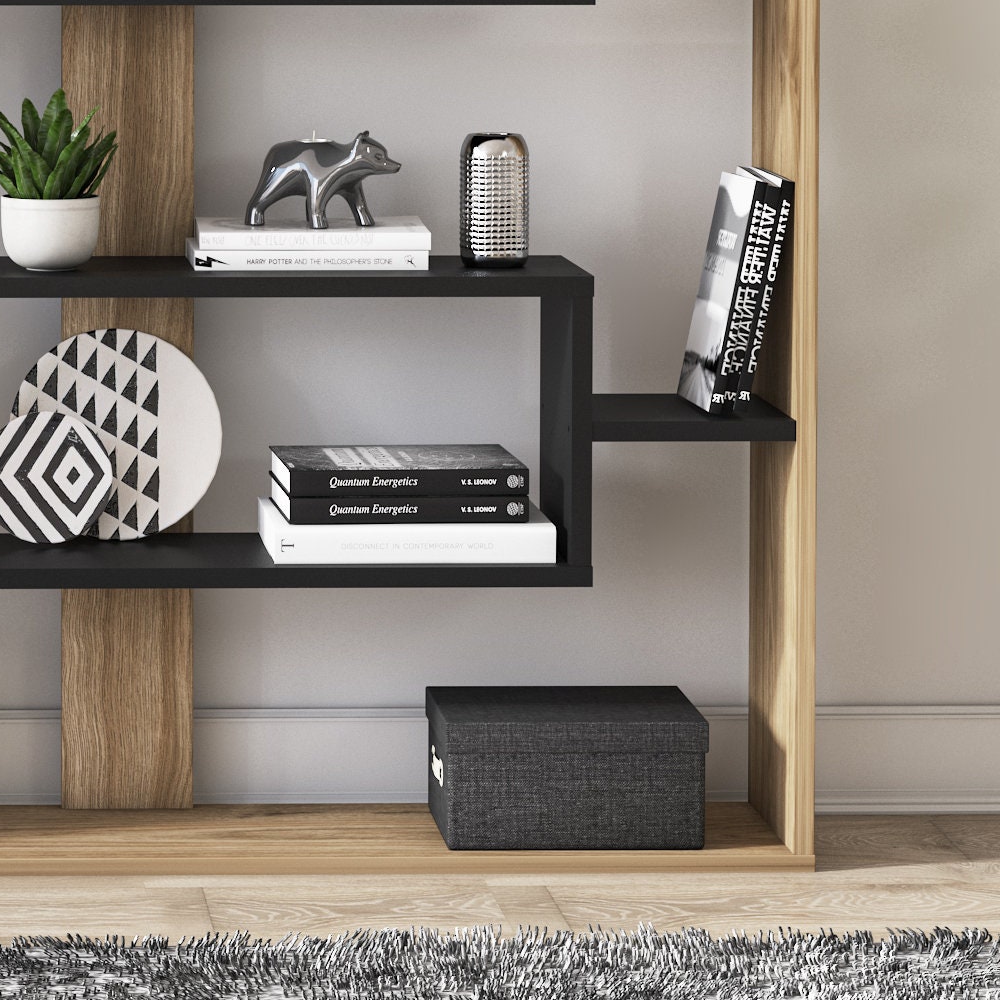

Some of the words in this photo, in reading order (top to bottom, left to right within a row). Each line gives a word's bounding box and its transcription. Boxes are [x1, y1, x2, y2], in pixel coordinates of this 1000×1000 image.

[246, 257, 266, 266] HARRY
[268, 257, 292, 266] POTTER
[294, 257, 308, 266] AND
[309, 257, 322, 266] THE
[323, 257, 372, 266] PHILOSOPHER'S
[373, 257, 393, 266] STONE
[329, 476, 370, 488] Quantum
[371, 476, 418, 488] Energetics
[329, 504, 370, 516] Quantum
[371, 504, 418, 516] Energetics
[281, 539, 294, 552] T
